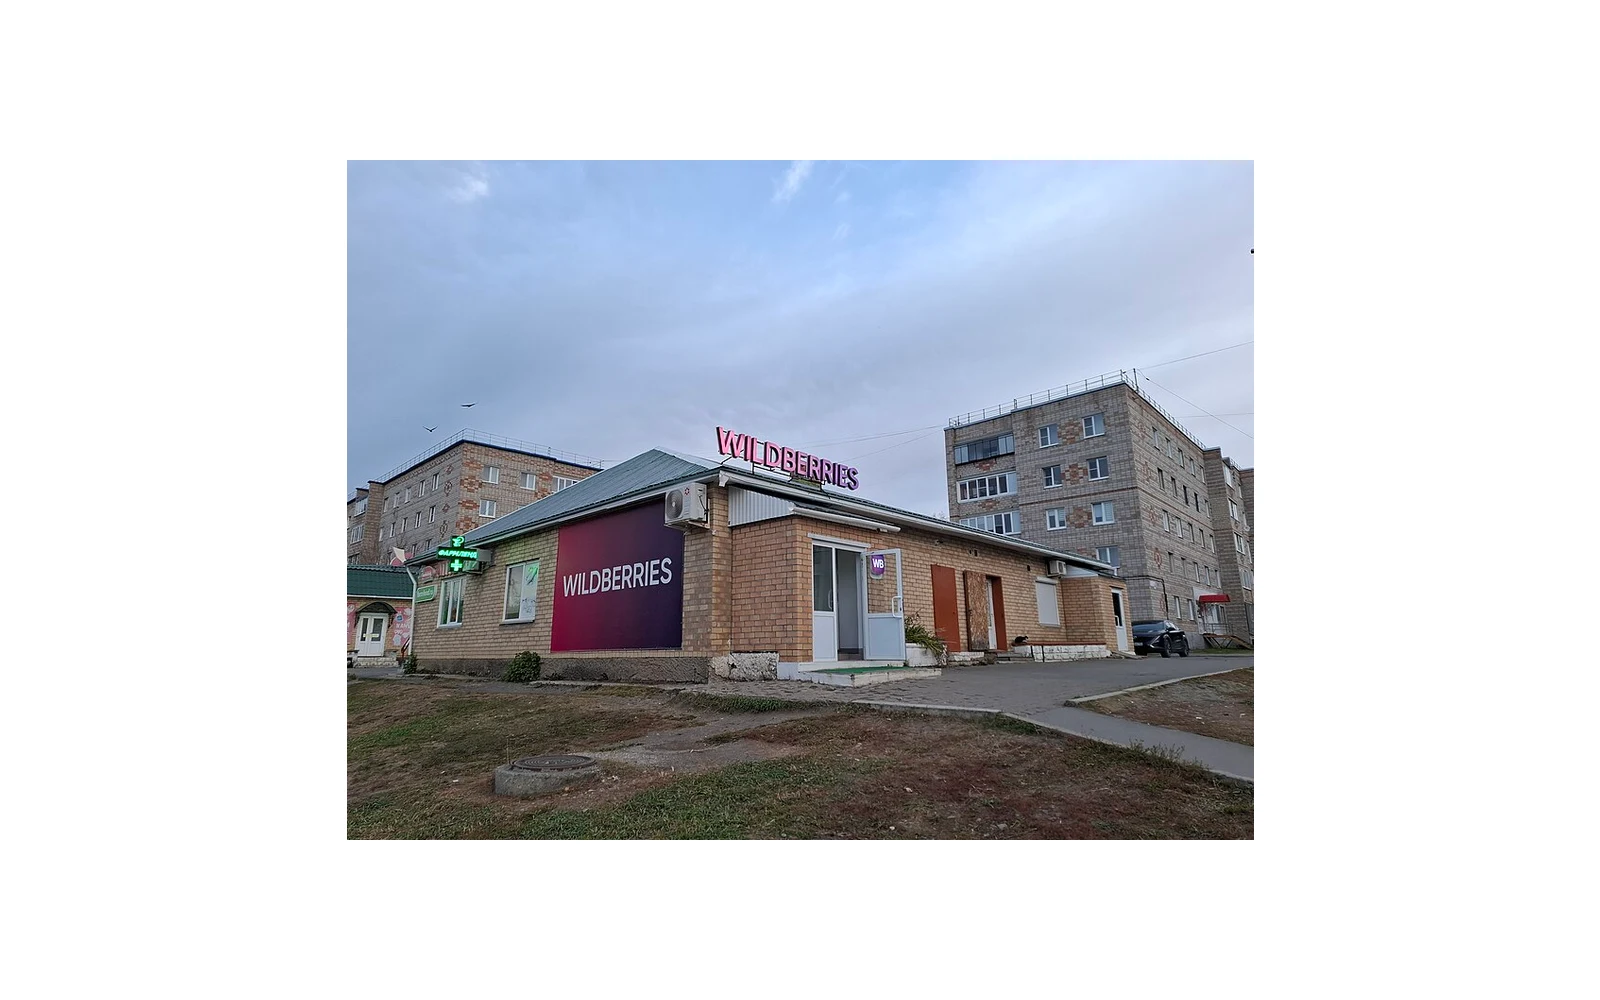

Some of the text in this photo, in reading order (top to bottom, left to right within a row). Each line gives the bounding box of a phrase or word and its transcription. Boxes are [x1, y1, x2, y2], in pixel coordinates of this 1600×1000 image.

[716, 426, 859, 490] WILDBERRIES
[563, 557, 672, 597] WILDBERRIES
[872, 558, 884, 569] WB
